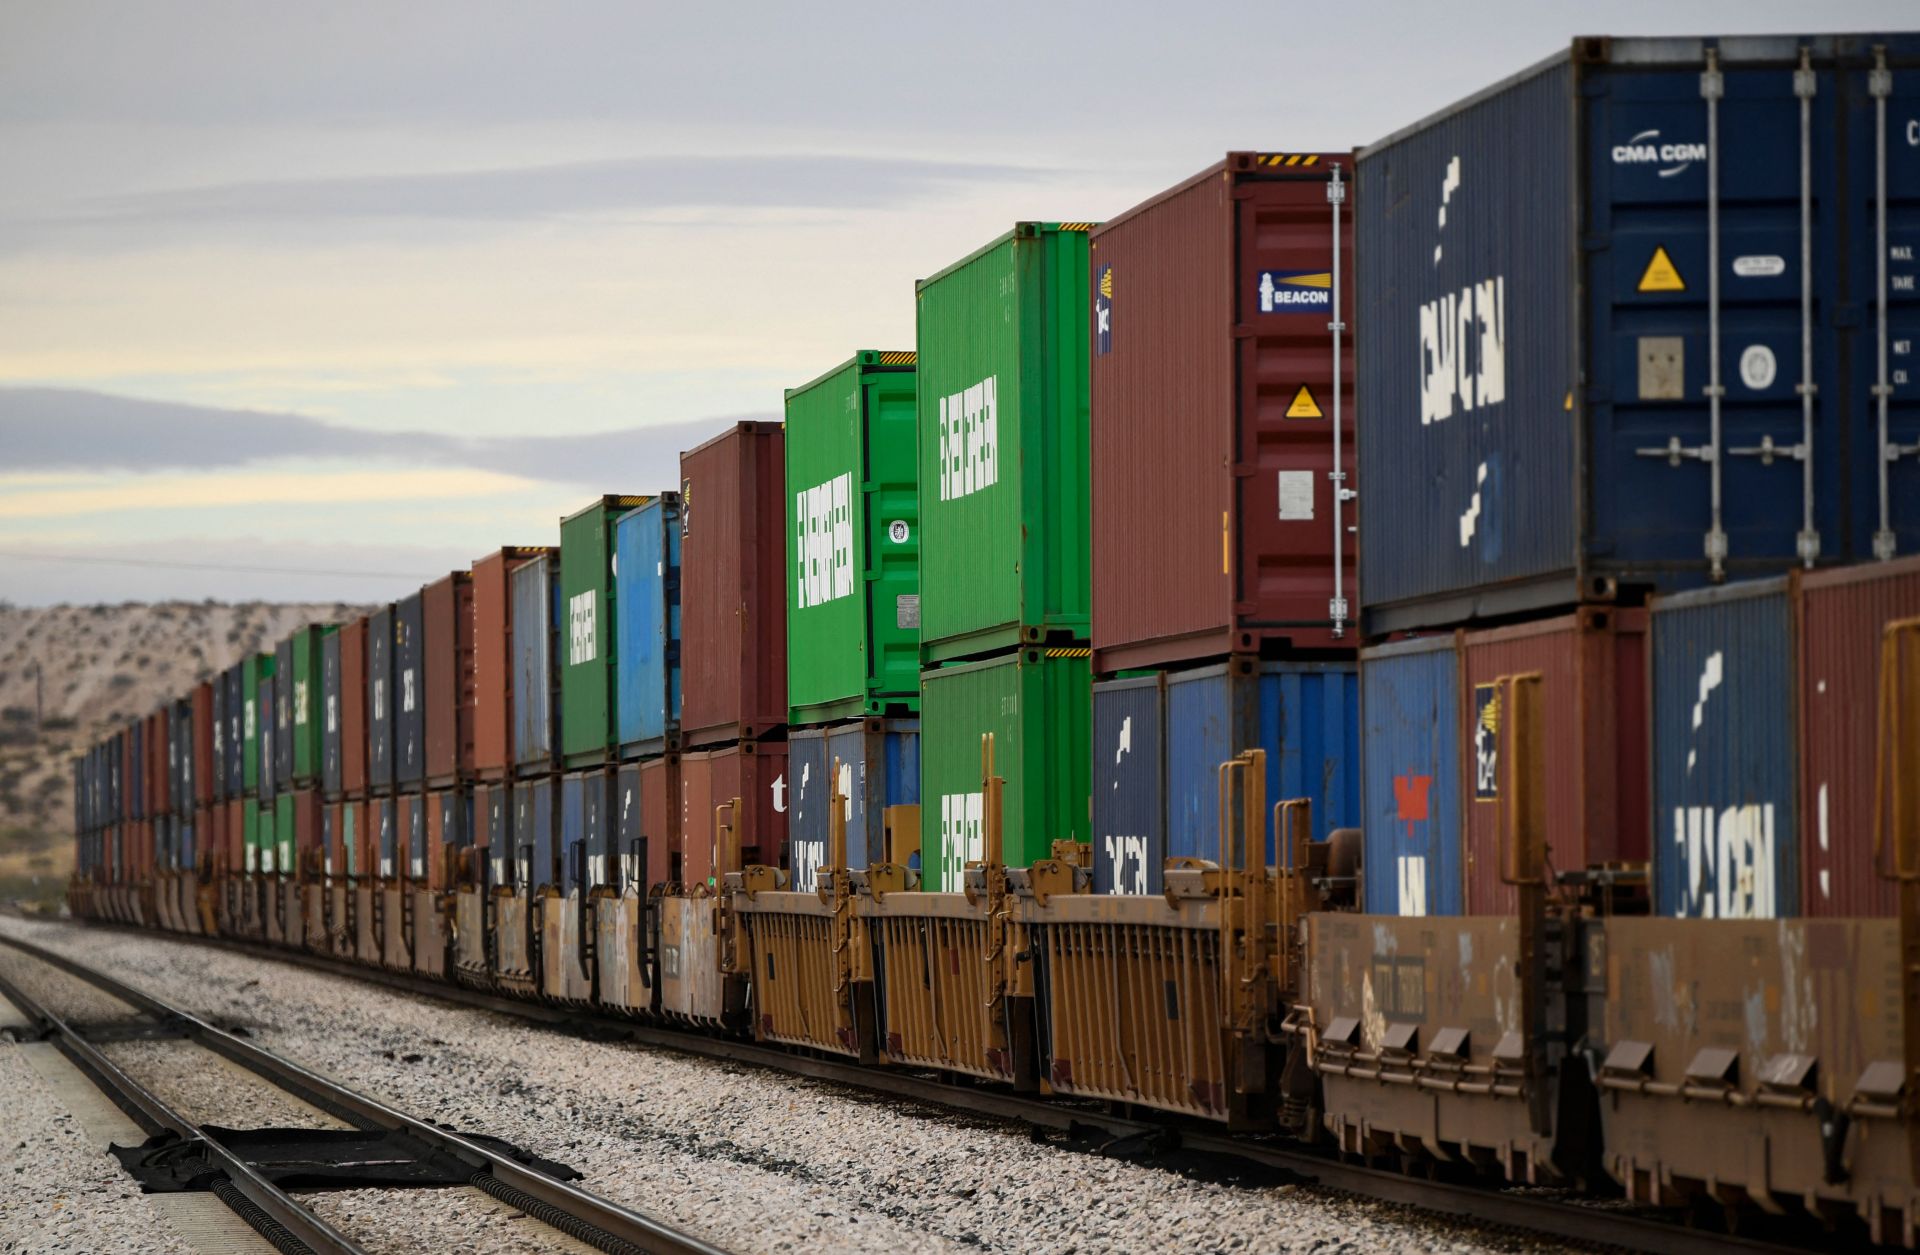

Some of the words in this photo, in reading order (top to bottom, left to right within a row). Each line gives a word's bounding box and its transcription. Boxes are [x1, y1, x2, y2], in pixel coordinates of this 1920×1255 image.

[1612, 145, 1658, 162] CMA
[1660, 143, 1706, 160] CGM
[1274, 291, 1329, 304] BEACON
[1893, 340, 1911, 354] NET
